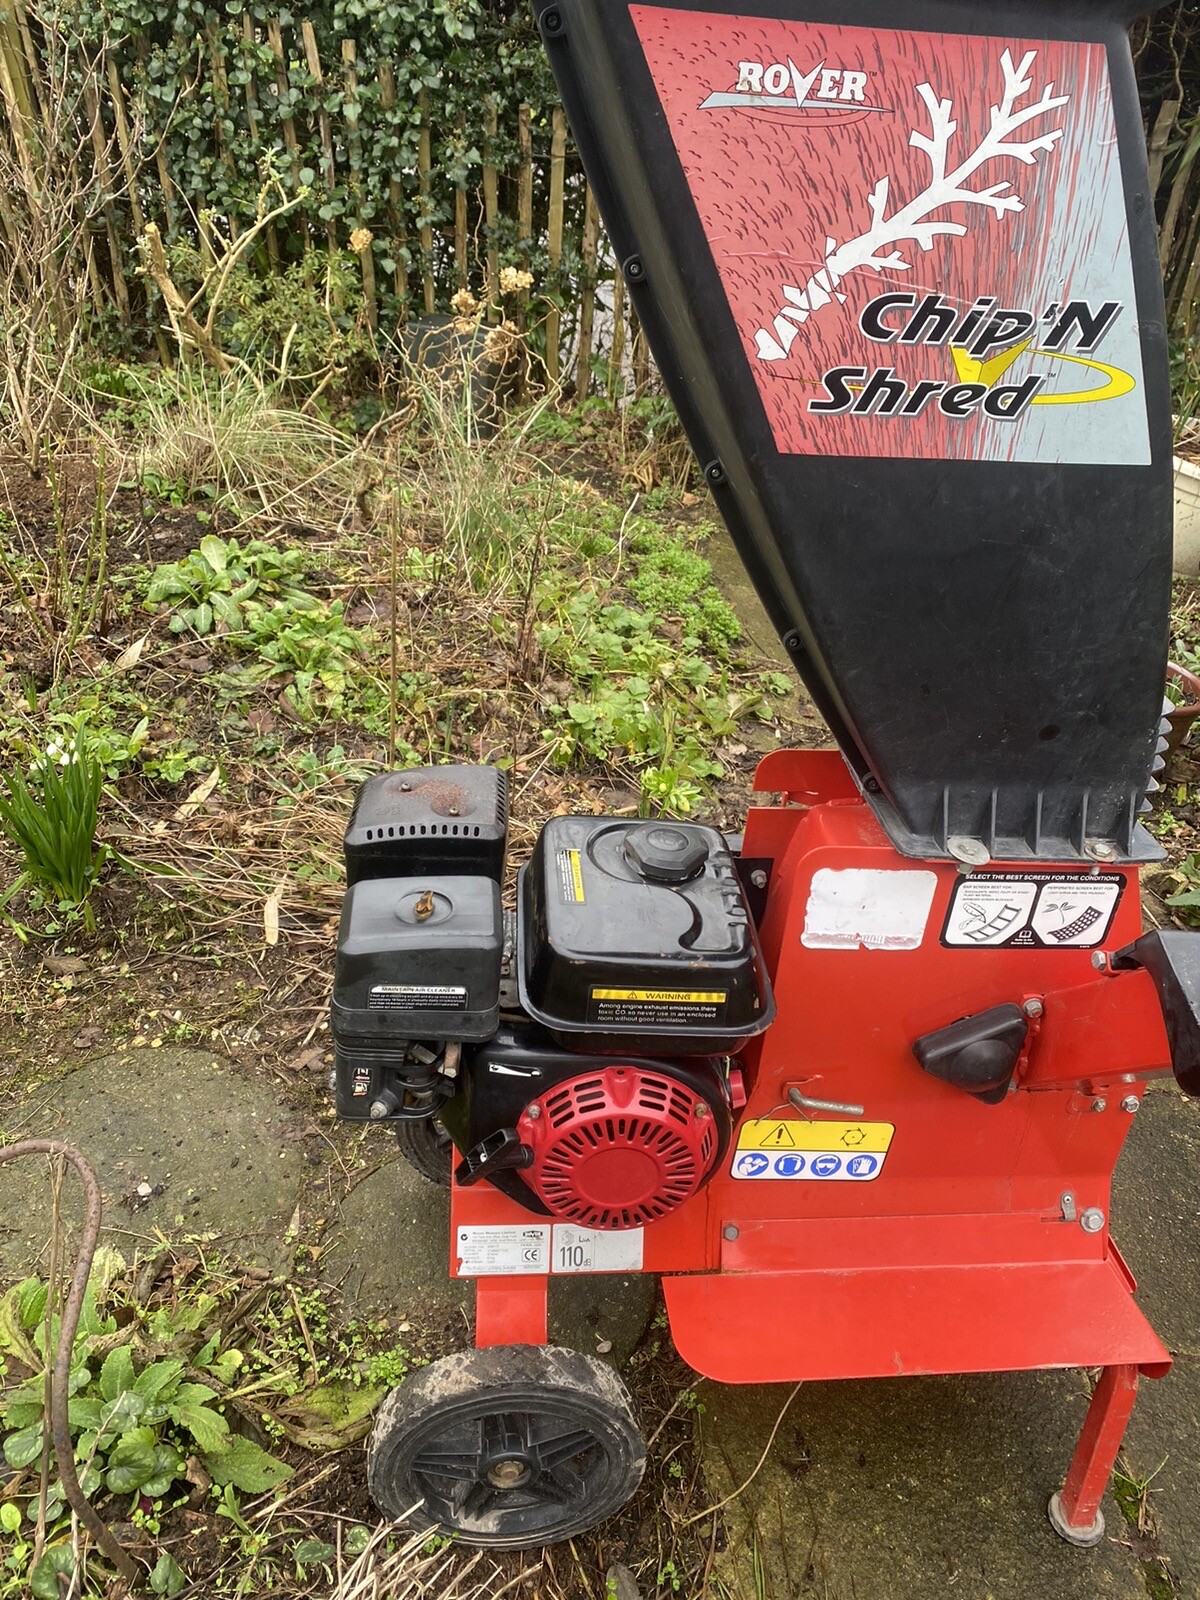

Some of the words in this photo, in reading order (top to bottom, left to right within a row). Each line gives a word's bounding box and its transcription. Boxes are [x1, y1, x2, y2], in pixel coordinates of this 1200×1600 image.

[735, 54, 868, 109] ROVER
[858, 291, 1037, 359] Chip
[806, 365, 1047, 422] Shred
[645, 992, 691, 1001] WARNING
[524, 1249, 538, 1261] CE
[560, 1245, 584, 1267] 110
